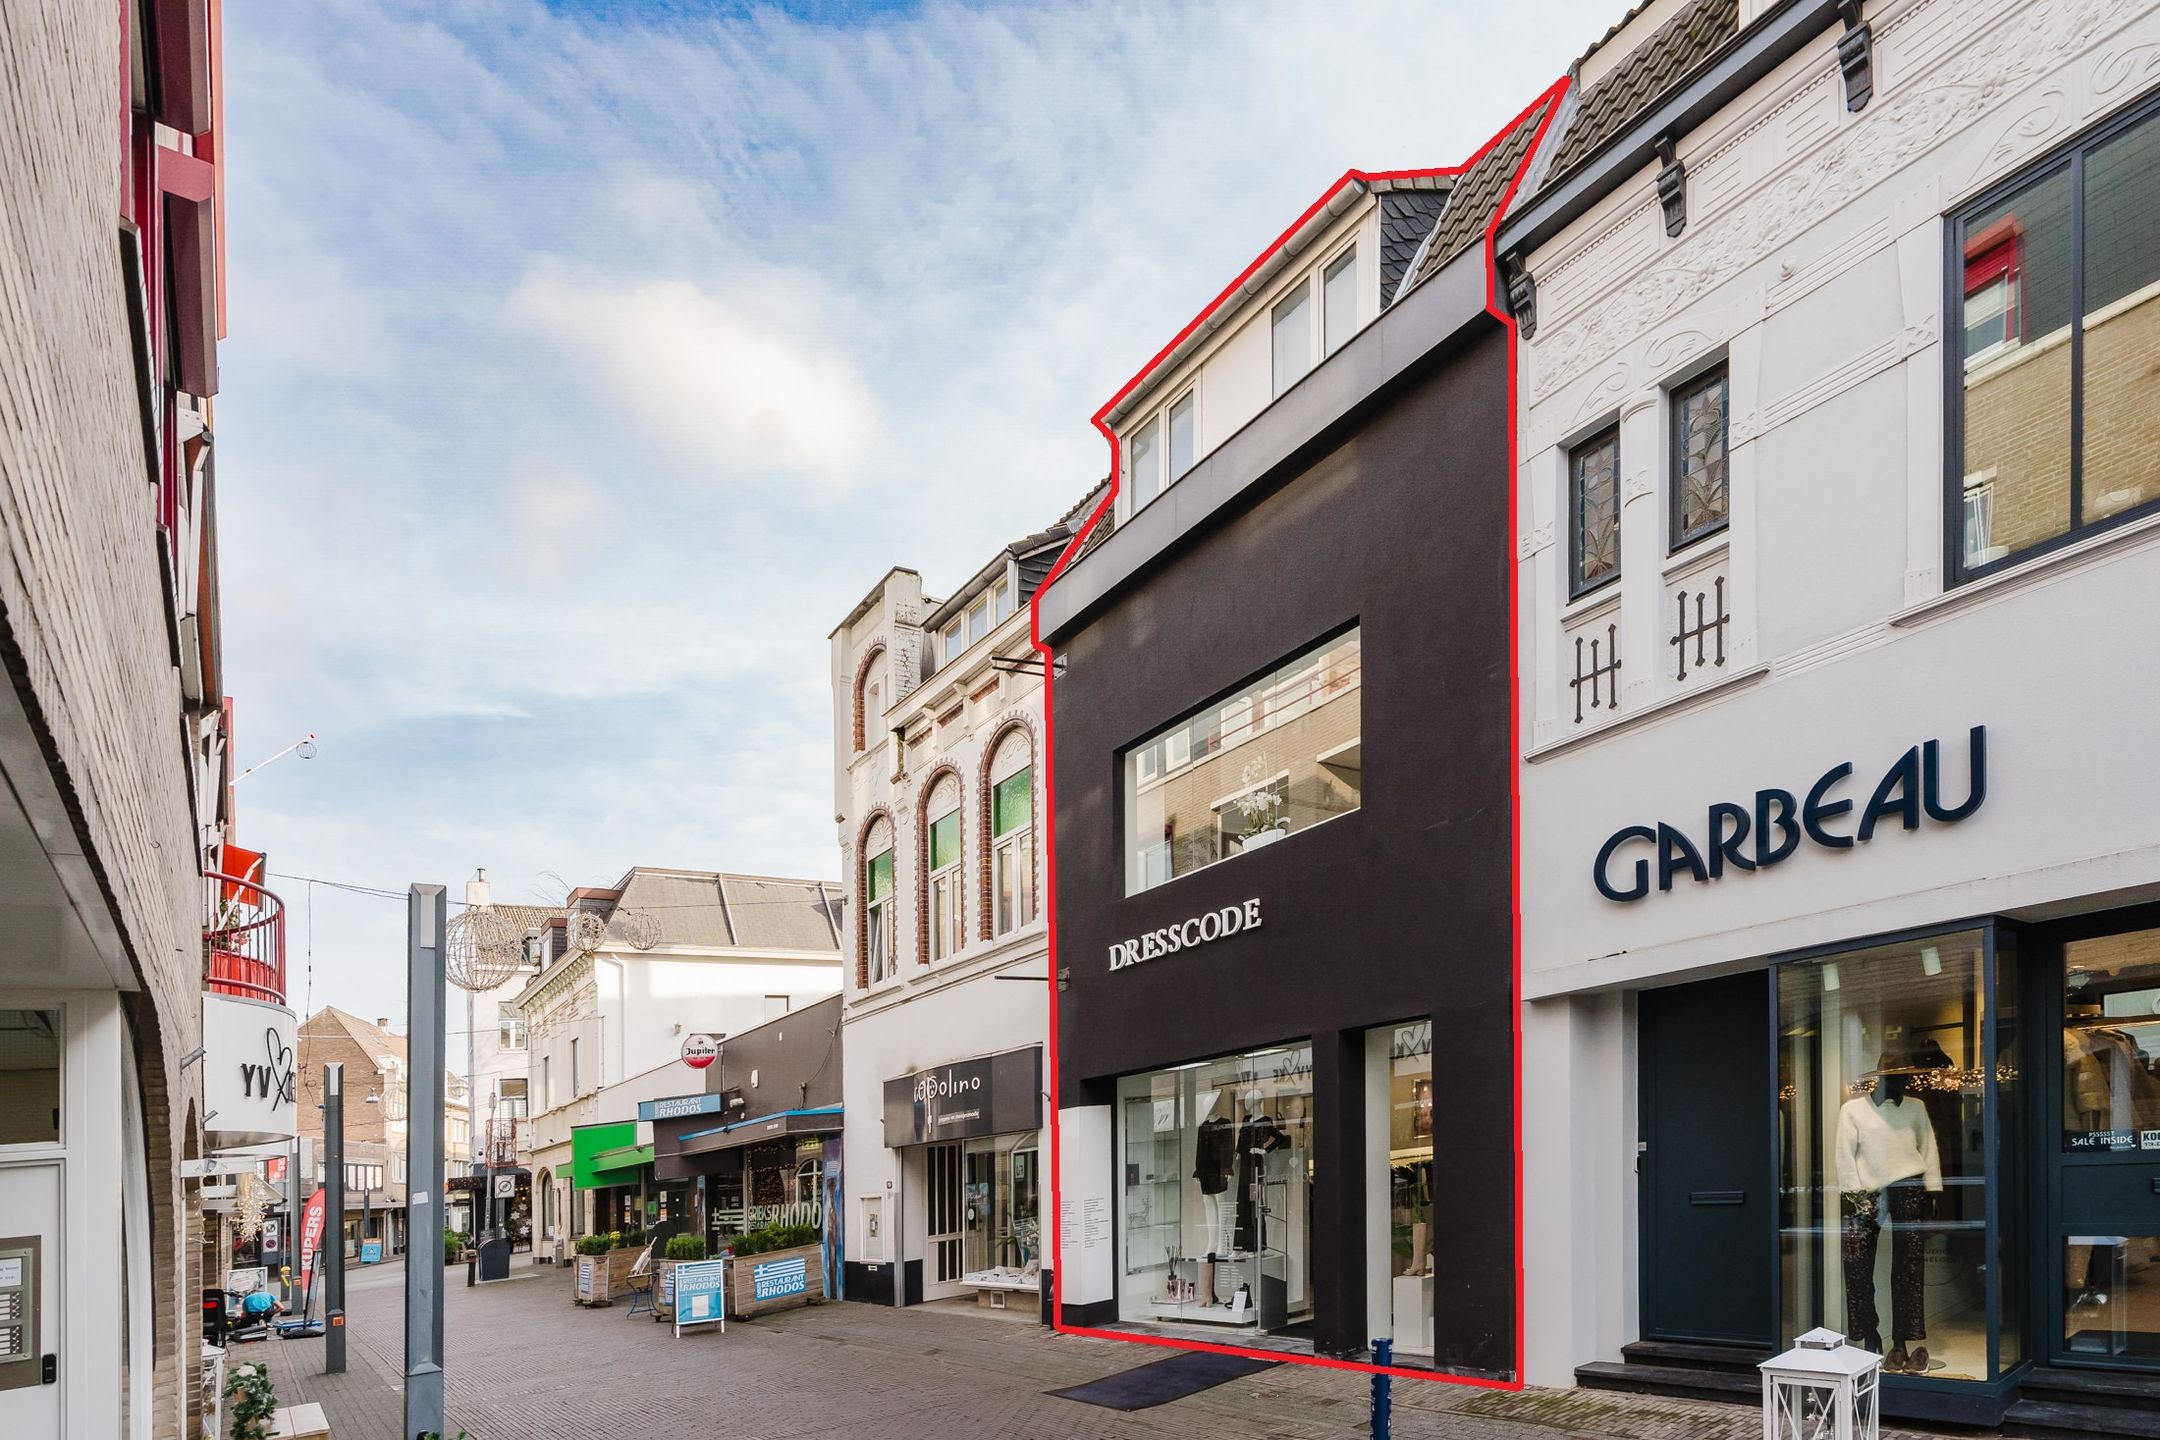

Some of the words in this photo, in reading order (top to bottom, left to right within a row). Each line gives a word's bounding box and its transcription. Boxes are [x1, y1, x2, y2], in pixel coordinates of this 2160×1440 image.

[1593, 724, 1988, 902] GARBEAU
[1108, 897, 1262, 971] DRESSCODE
[686, 1047, 716, 1056] Jupiler
[660, 1104, 702, 1118] RHODOS
[2072, 1137, 2095, 1147] SALE
[2100, 1135, 2133, 1145] INSIDE
[748, 1204, 771, 1221] GRIEKS
[302, 1206, 323, 1271] KUPERS
[683, 1275, 720, 1285] RESTAURANT
[684, 1281, 720, 1292] RHODOS
[761, 1274, 804, 1289] RESTAURANT
[762, 1280, 805, 1298] RHODOS
